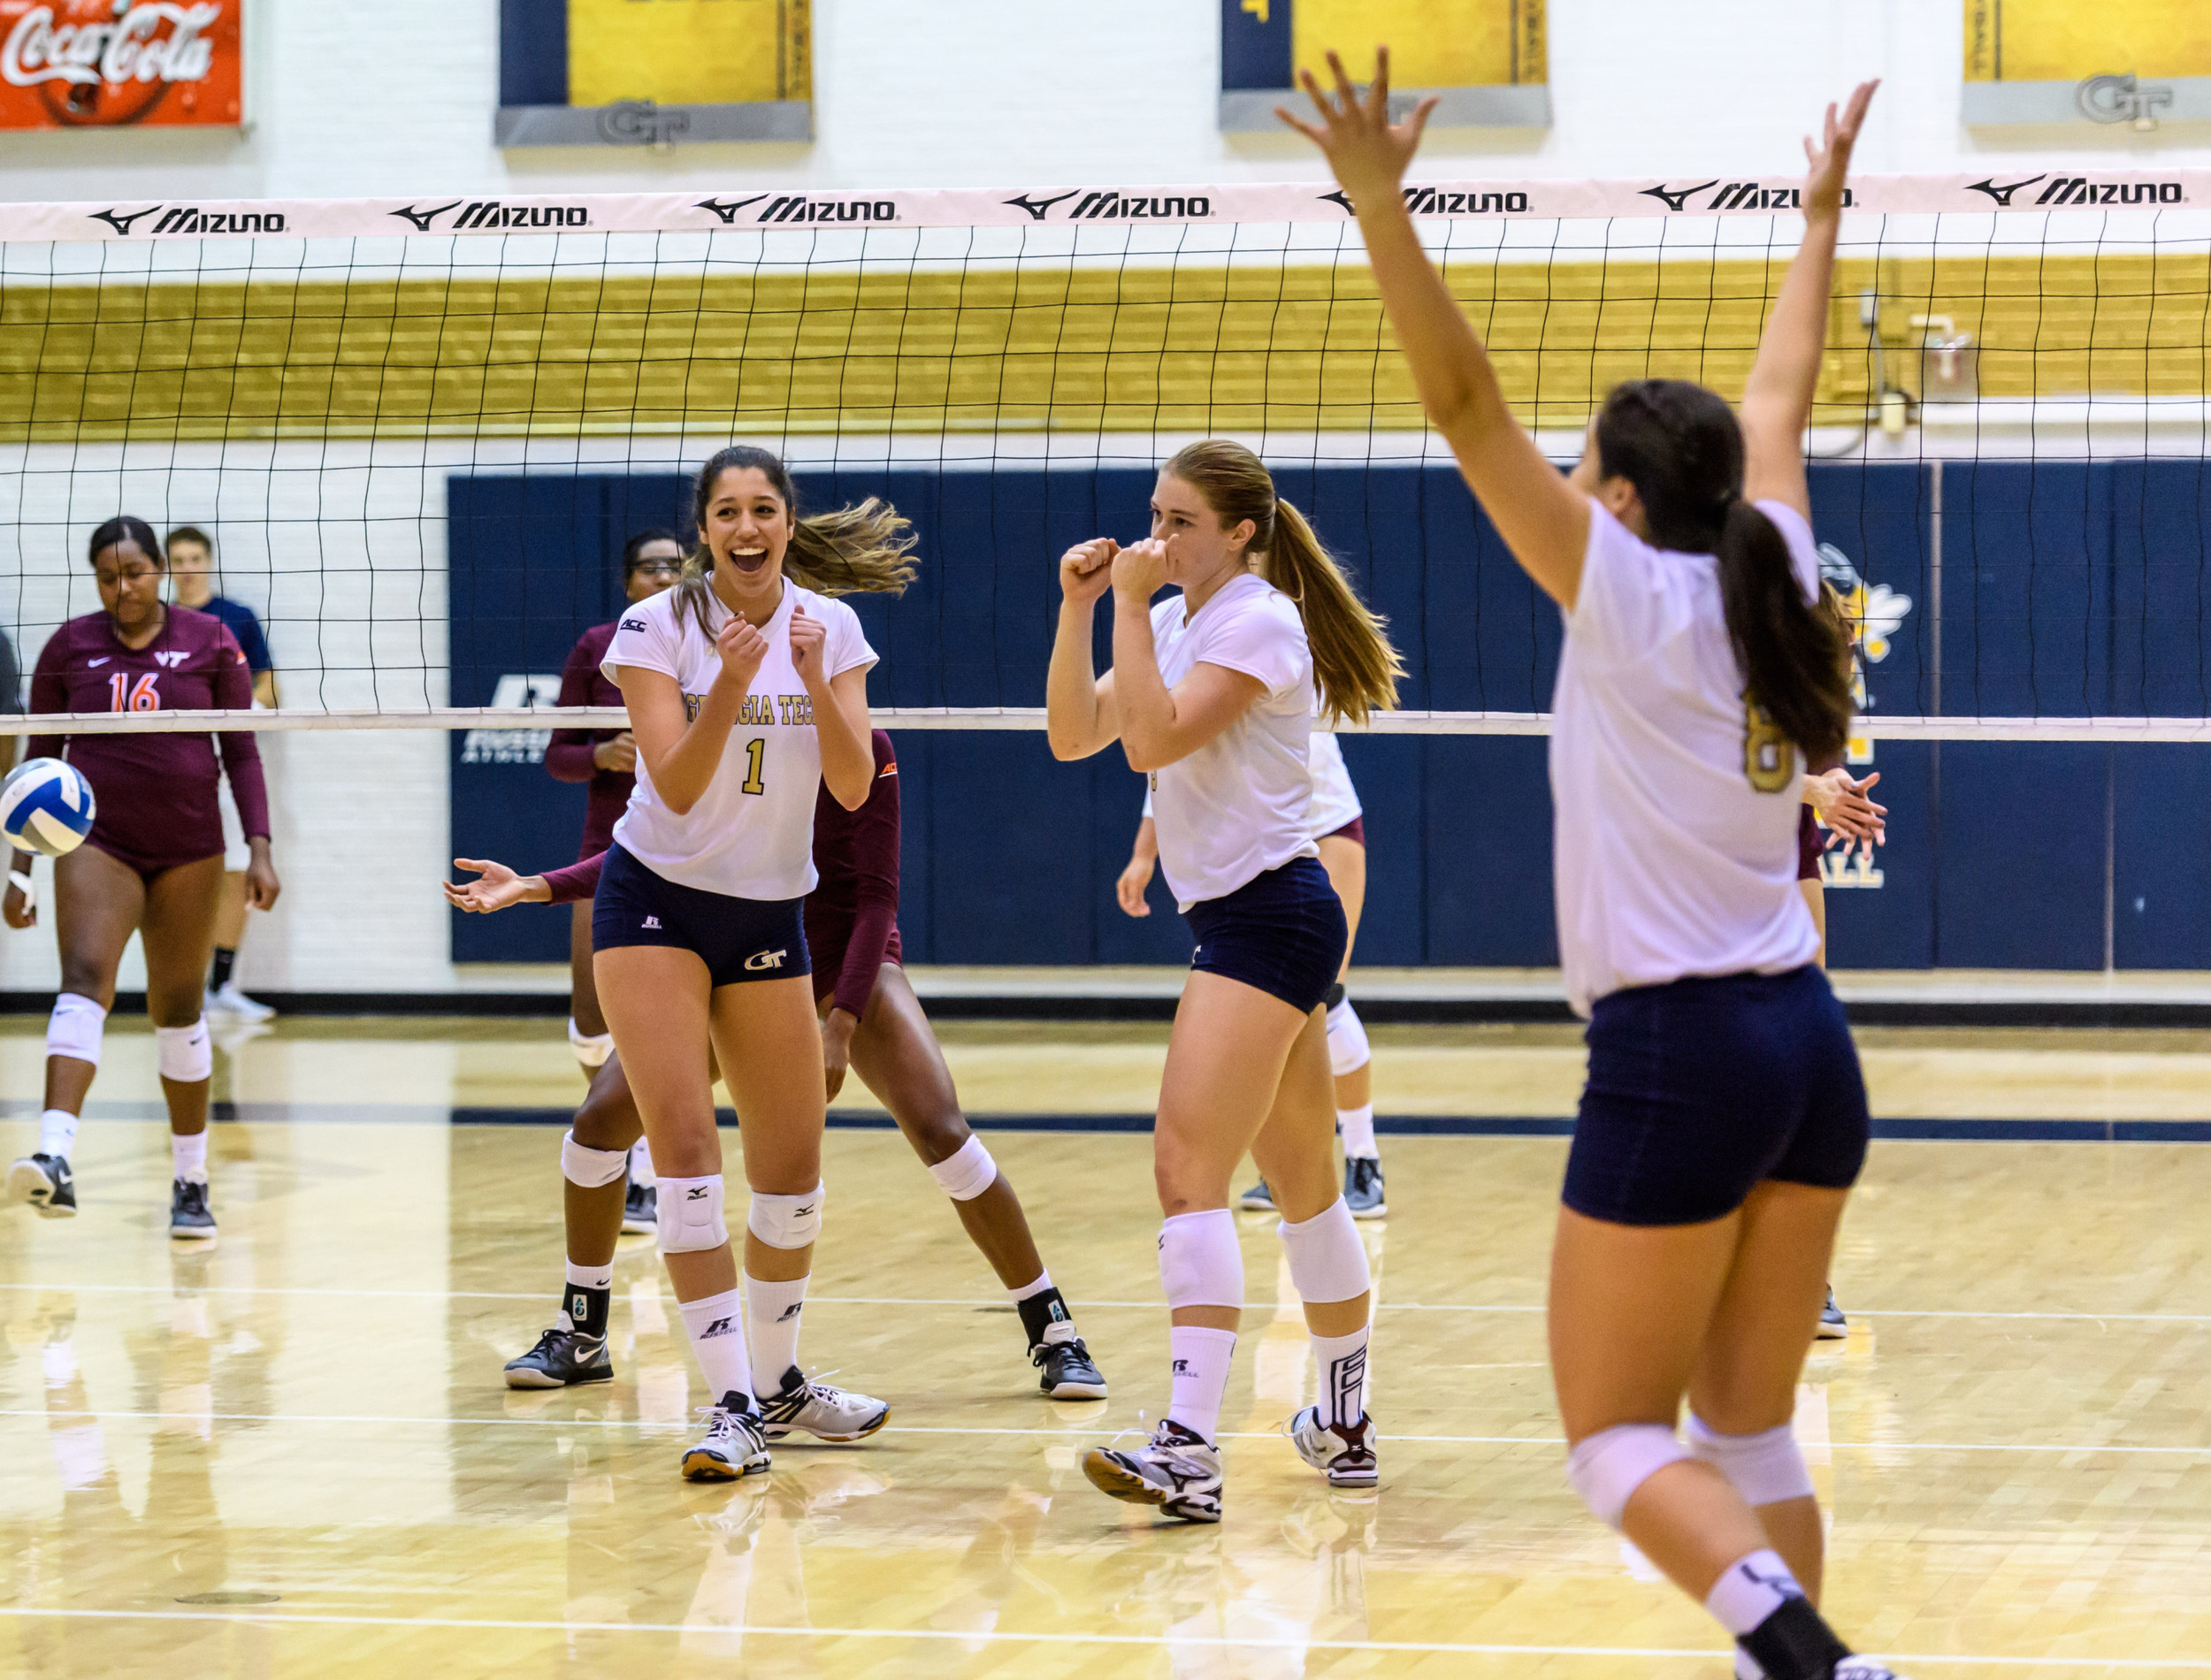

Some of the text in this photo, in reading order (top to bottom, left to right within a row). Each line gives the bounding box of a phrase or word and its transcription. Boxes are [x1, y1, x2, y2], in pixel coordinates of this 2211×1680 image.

[151, 208, 286, 233] MIZUNO
[452, 202, 588, 229] MIZUNO
[758, 196, 896, 222] MIZUNO
[1069, 192, 1211, 218] MIZUNO
[2036, 178, 2182, 205] MIZUNO
[620, 618, 646, 633] ACC
[154, 651, 191, 668] VT
[109, 672, 161, 713] 16
[685, 693, 817, 726] GGIA TEC
[741, 738, 765, 796] 1
[744, 950, 786, 971] GT
